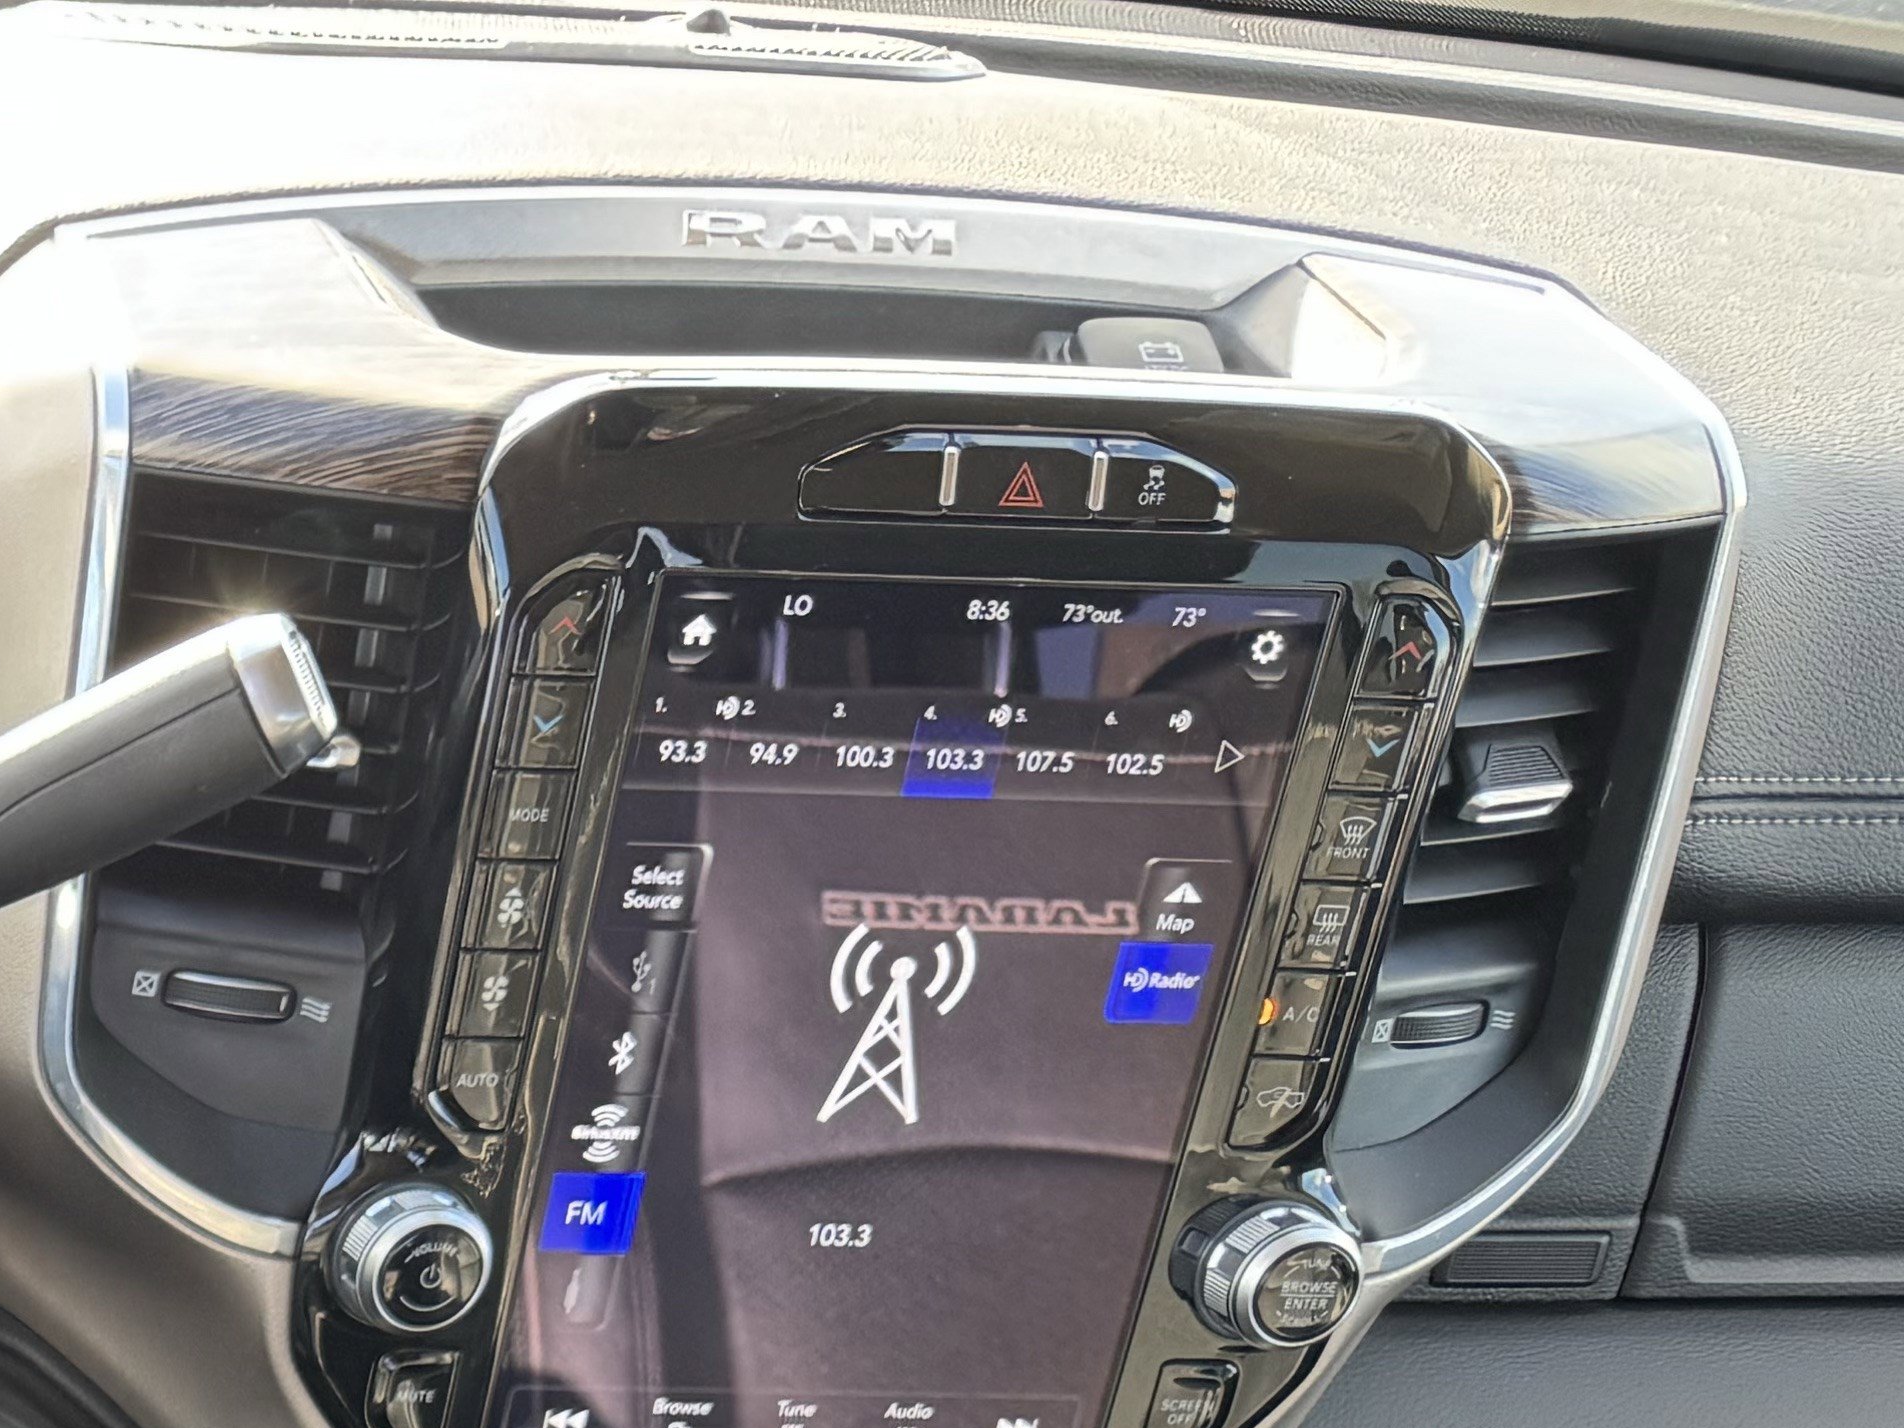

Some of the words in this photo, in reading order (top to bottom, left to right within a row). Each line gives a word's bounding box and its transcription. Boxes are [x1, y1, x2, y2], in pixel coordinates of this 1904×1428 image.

[682, 209, 957, 256] RAM
[1138, 491, 1166, 506] OFF
[782, 594, 814, 616] LO
[965, 598, 1011, 622] 8:36
[658, 739, 709, 764] 93.3
[748, 743, 800, 767] 94.9
[835, 745, 895, 770] 100.3
[925, 747, 986, 772] 103.3
[1016, 750, 1077, 775] 107.5
[1105, 752, 1166, 777] 102.5
[508, 807, 550, 824] MODE
[1326, 846, 1371, 860] FRONT
[630, 863, 686, 887] Select
[622, 888, 684, 910] Source
[1155, 913, 1195, 934] Map
[1306, 932, 1341, 946] REAR
[1282, 1006, 1318, 1023] A/C
[456, 1073, 500, 1089] AUTO
[564, 1199, 609, 1226] FM
[809, 1222, 874, 1248] 103.3
[1280, 1281, 1339, 1294] BROWSE
[1283, 1298, 1329, 1311] ENTER
[652, 1396, 715, 1416] Browse
[777, 1398, 818, 1418] Tune
[883, 1401, 936, 1420] Audio
